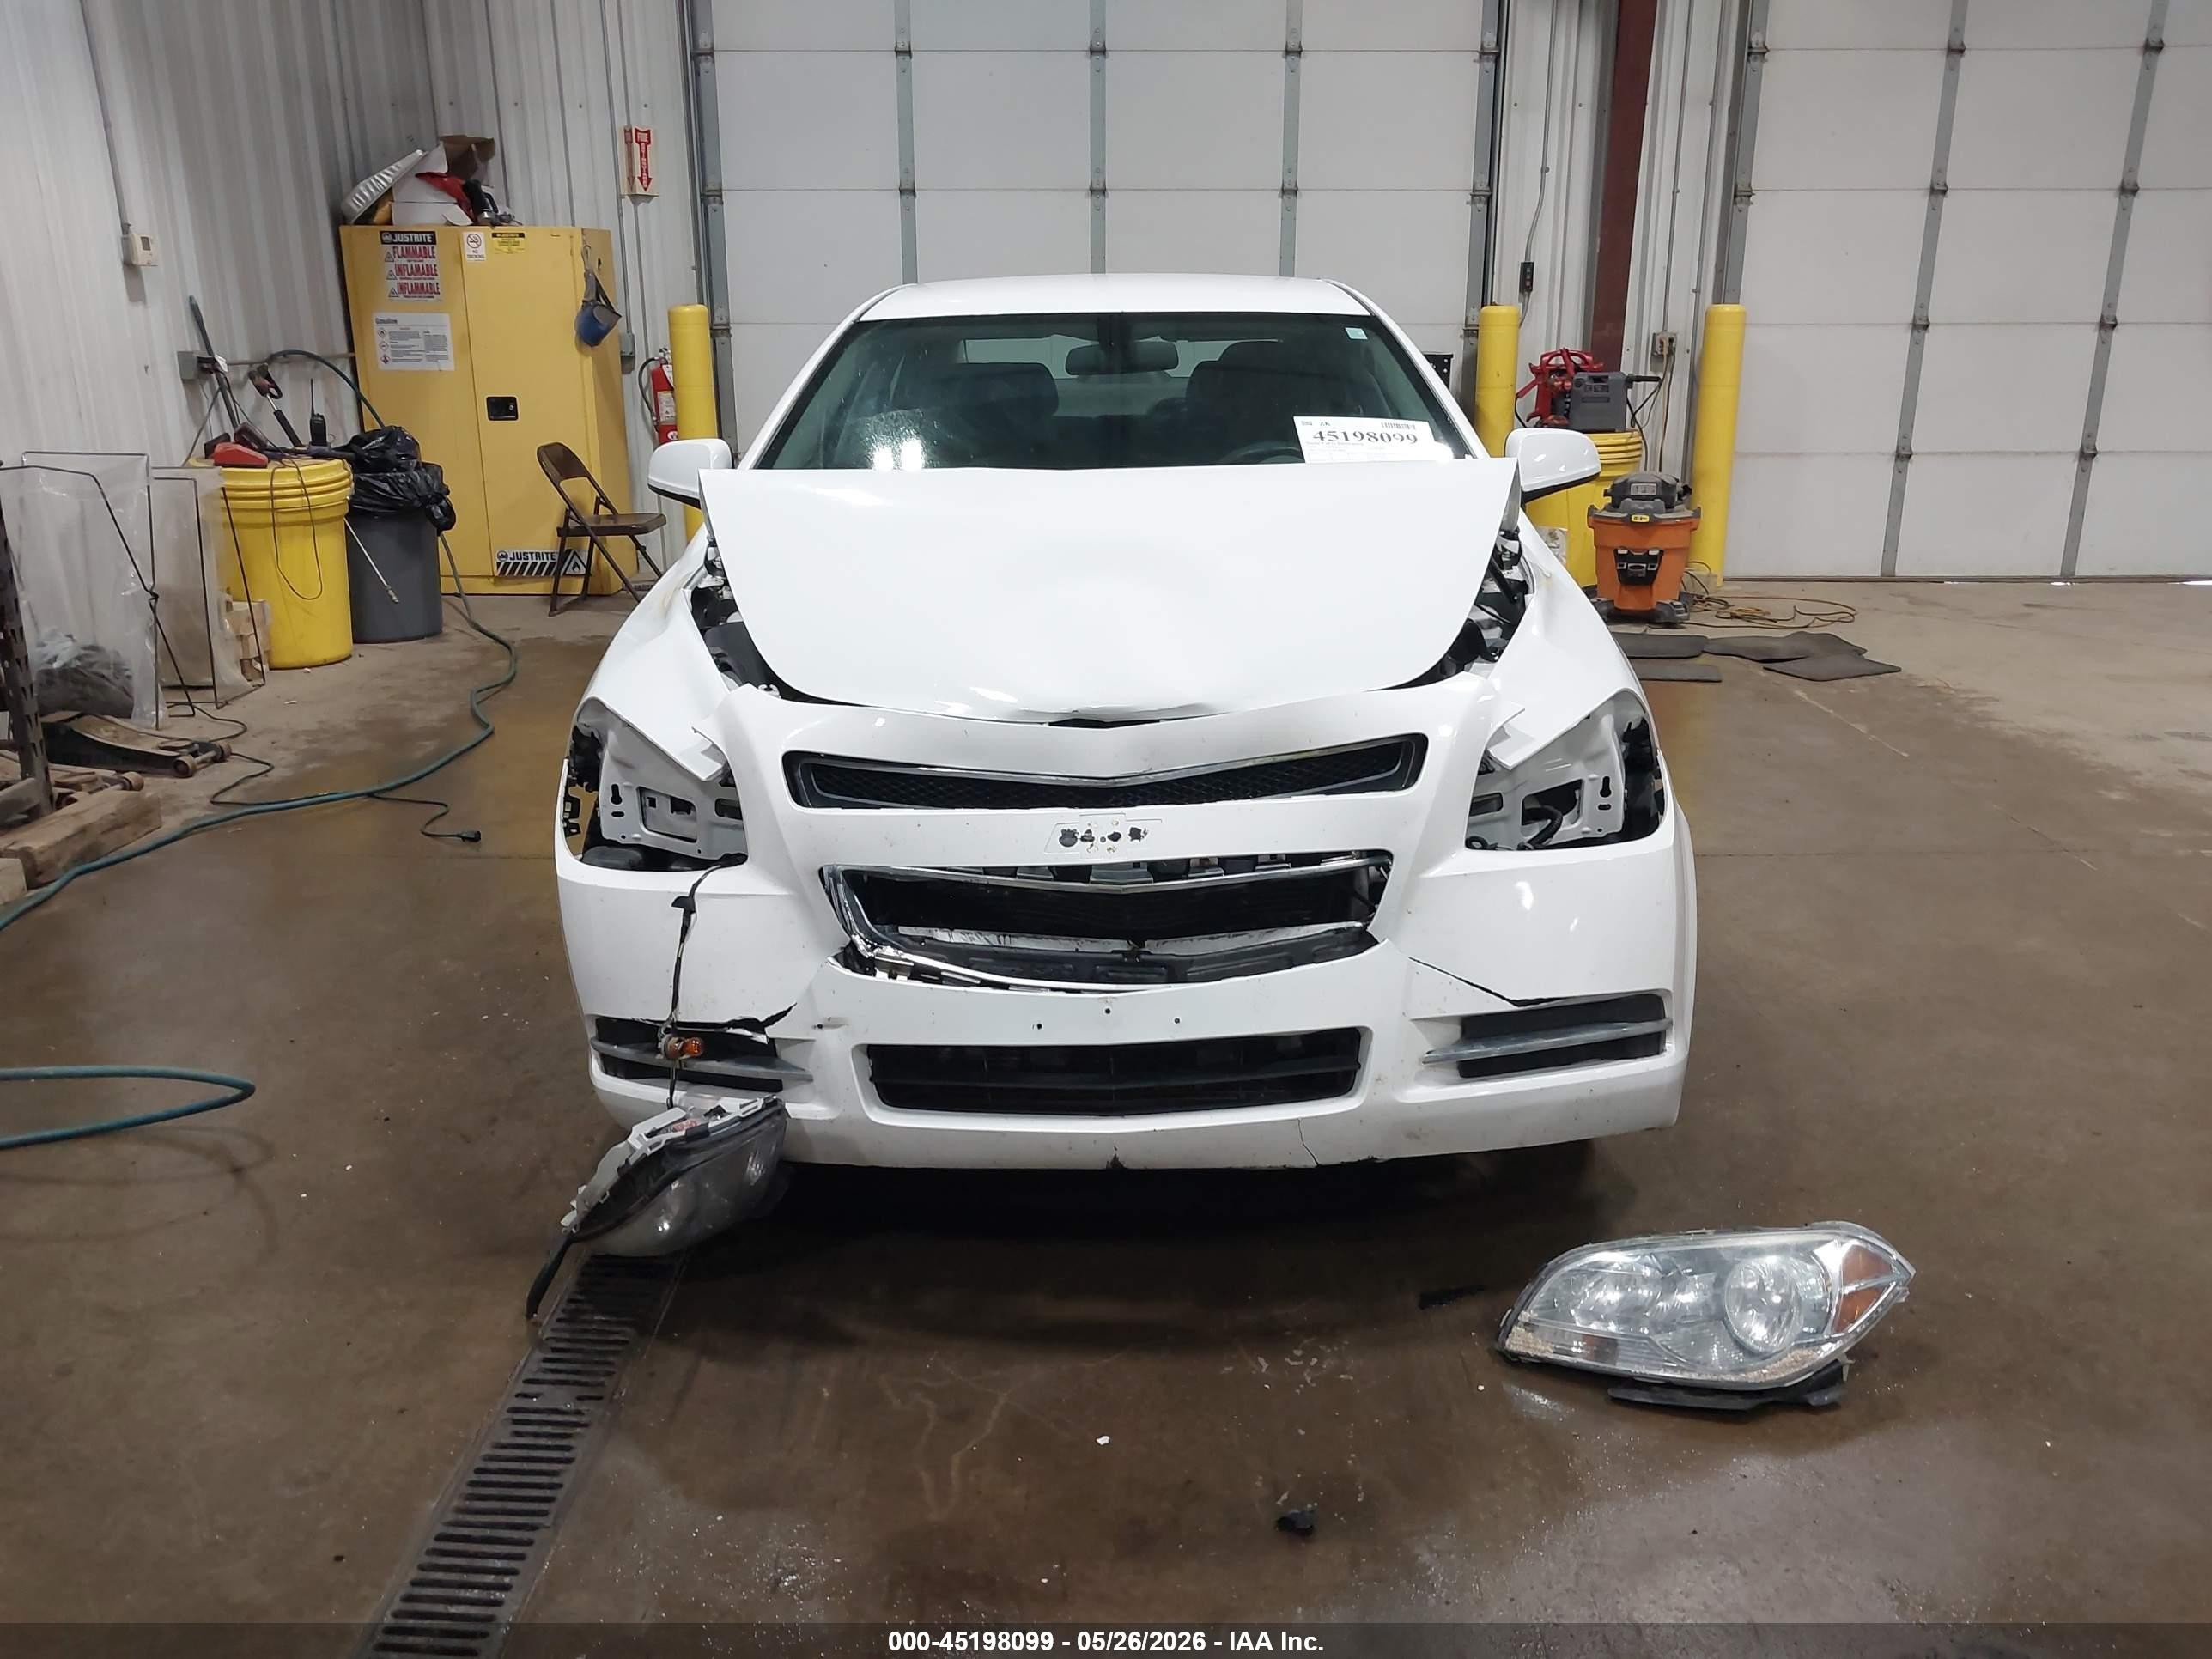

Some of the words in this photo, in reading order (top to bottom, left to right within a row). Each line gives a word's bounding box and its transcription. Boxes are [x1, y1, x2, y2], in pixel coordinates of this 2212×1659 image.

[392, 233, 433, 242] JUSTRITE
[392, 246, 435, 258] FLAMMABLE
[395, 264, 439, 276] INFLAMABLE
[397, 282, 440, 295] INFLAMMABLE
[1313, 430, 1418, 444] 45198099
[509, 551, 556, 561] JUSTRITE
